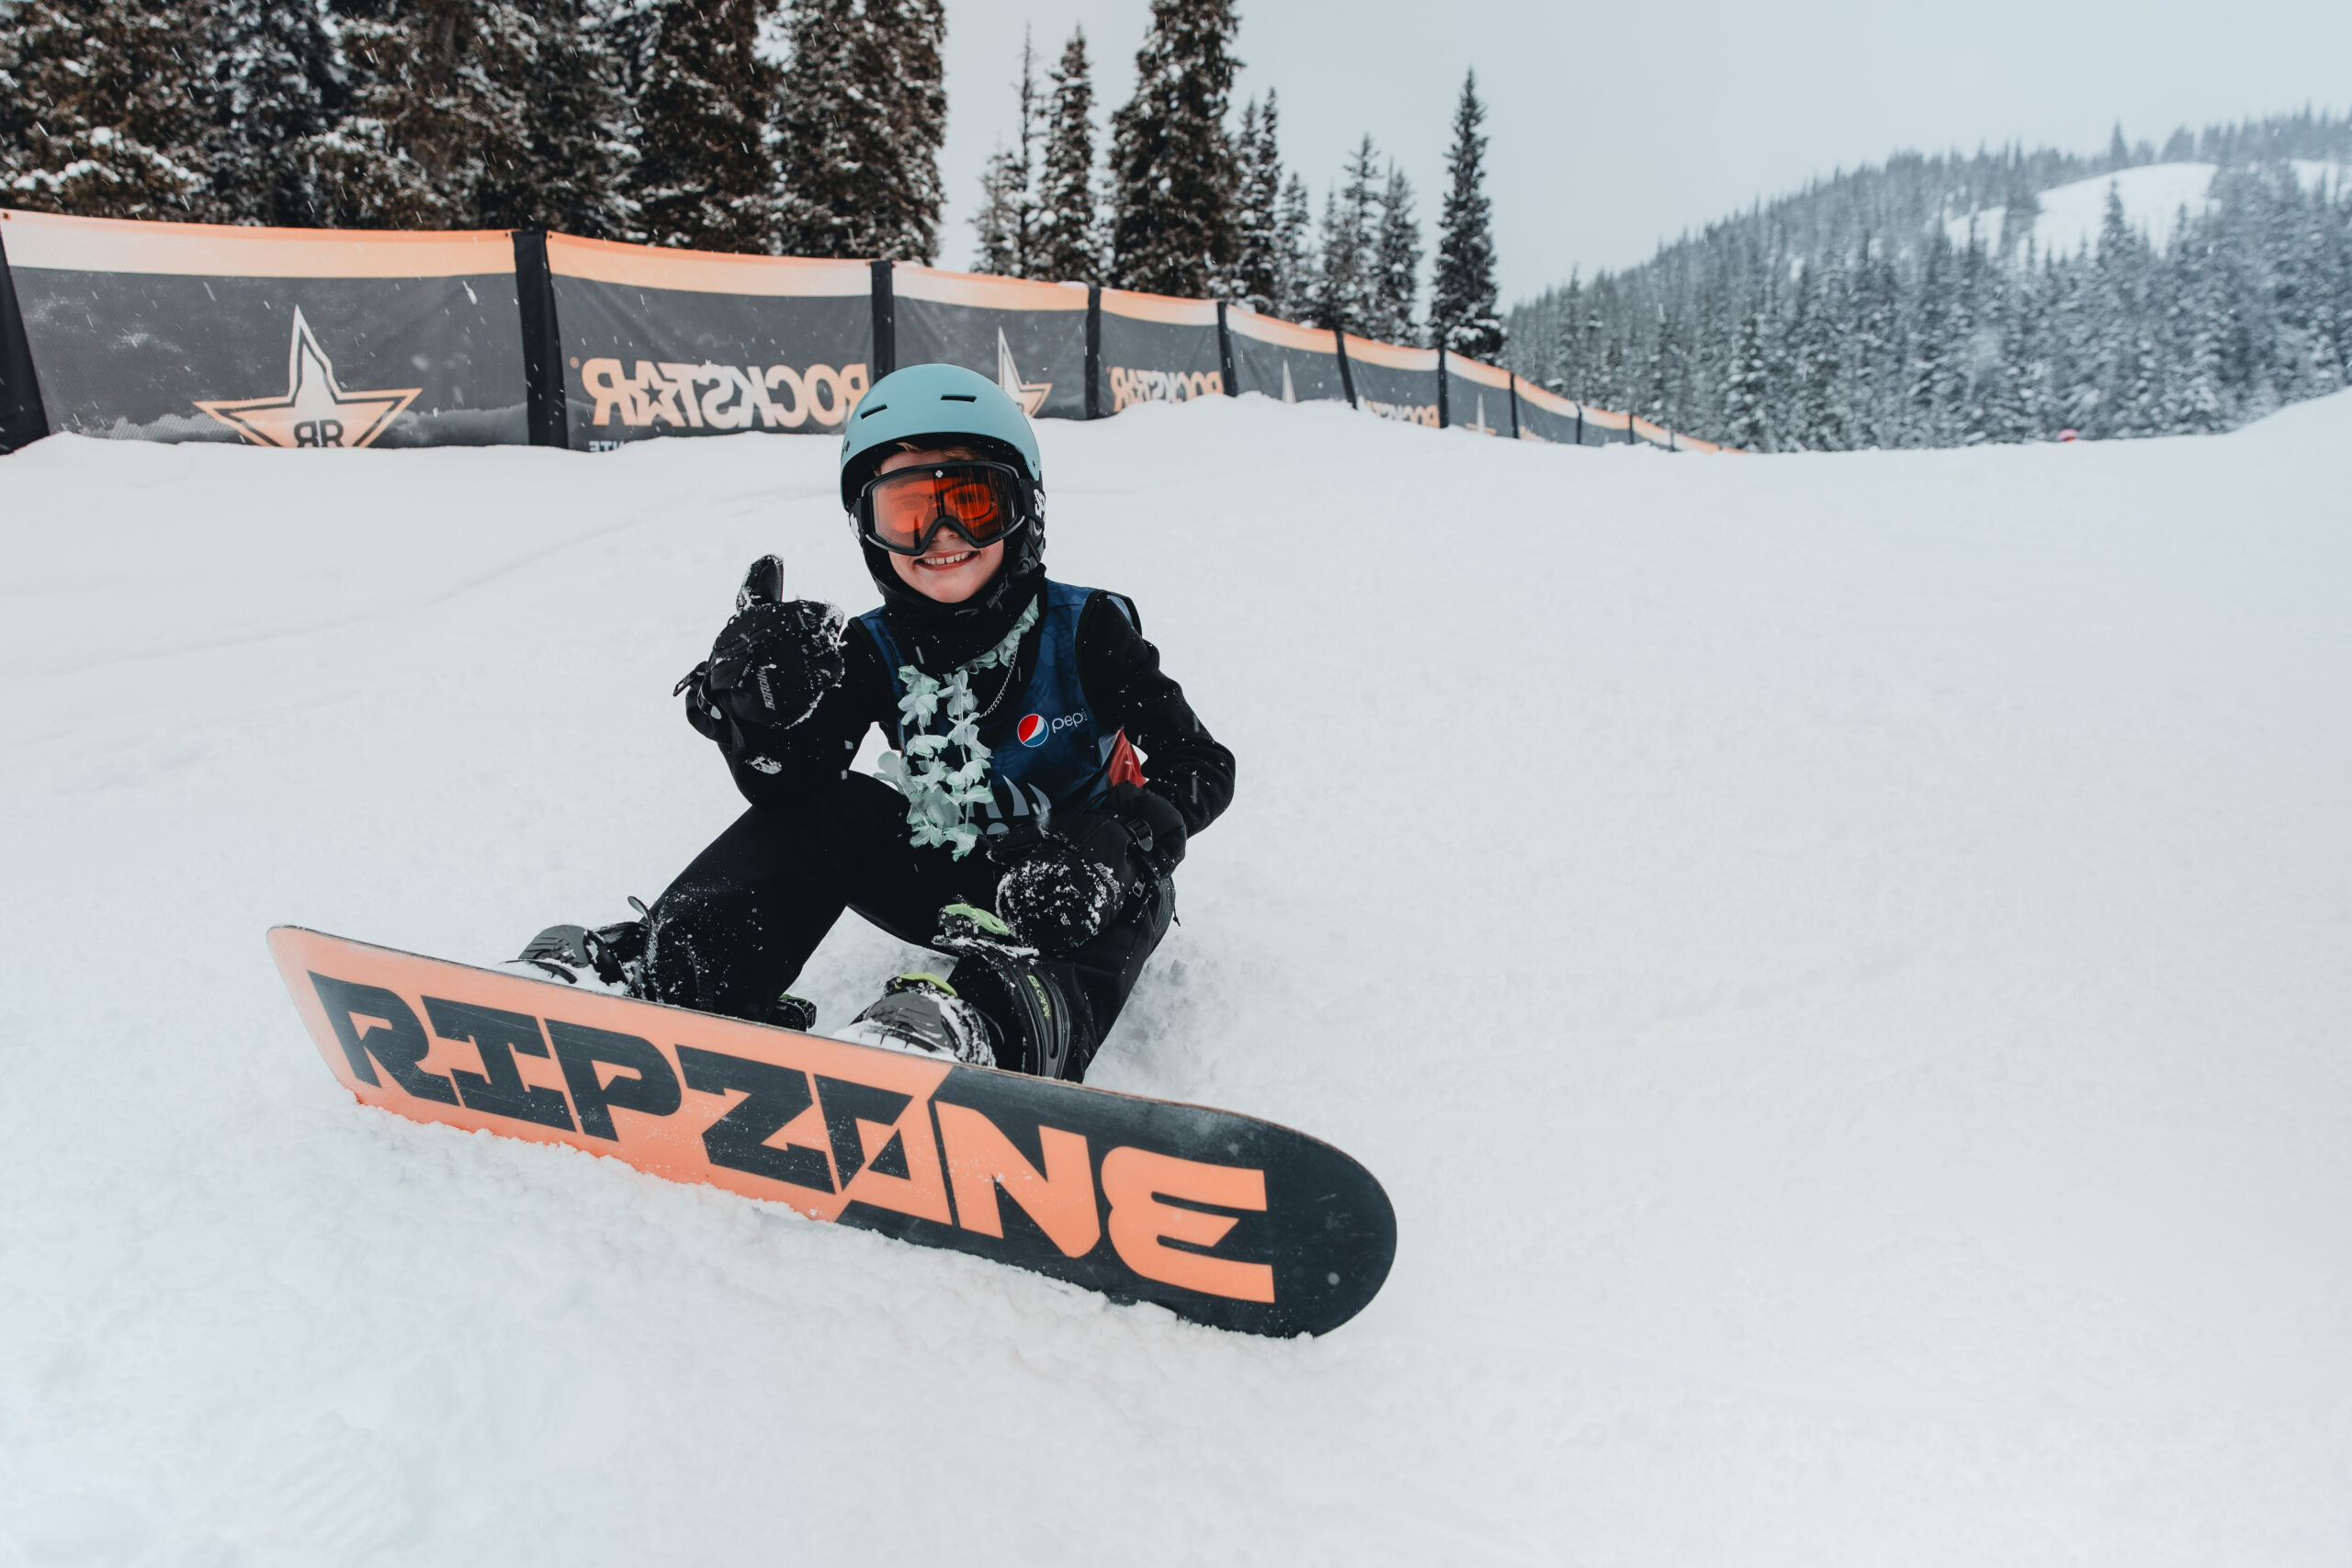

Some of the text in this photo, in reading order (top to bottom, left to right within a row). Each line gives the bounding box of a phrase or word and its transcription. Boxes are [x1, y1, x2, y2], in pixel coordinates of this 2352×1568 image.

[756, 666, 775, 711] GORDIN
[1051, 707, 1088, 734] pep
[307, 970, 1275, 1303] RIPZONE
